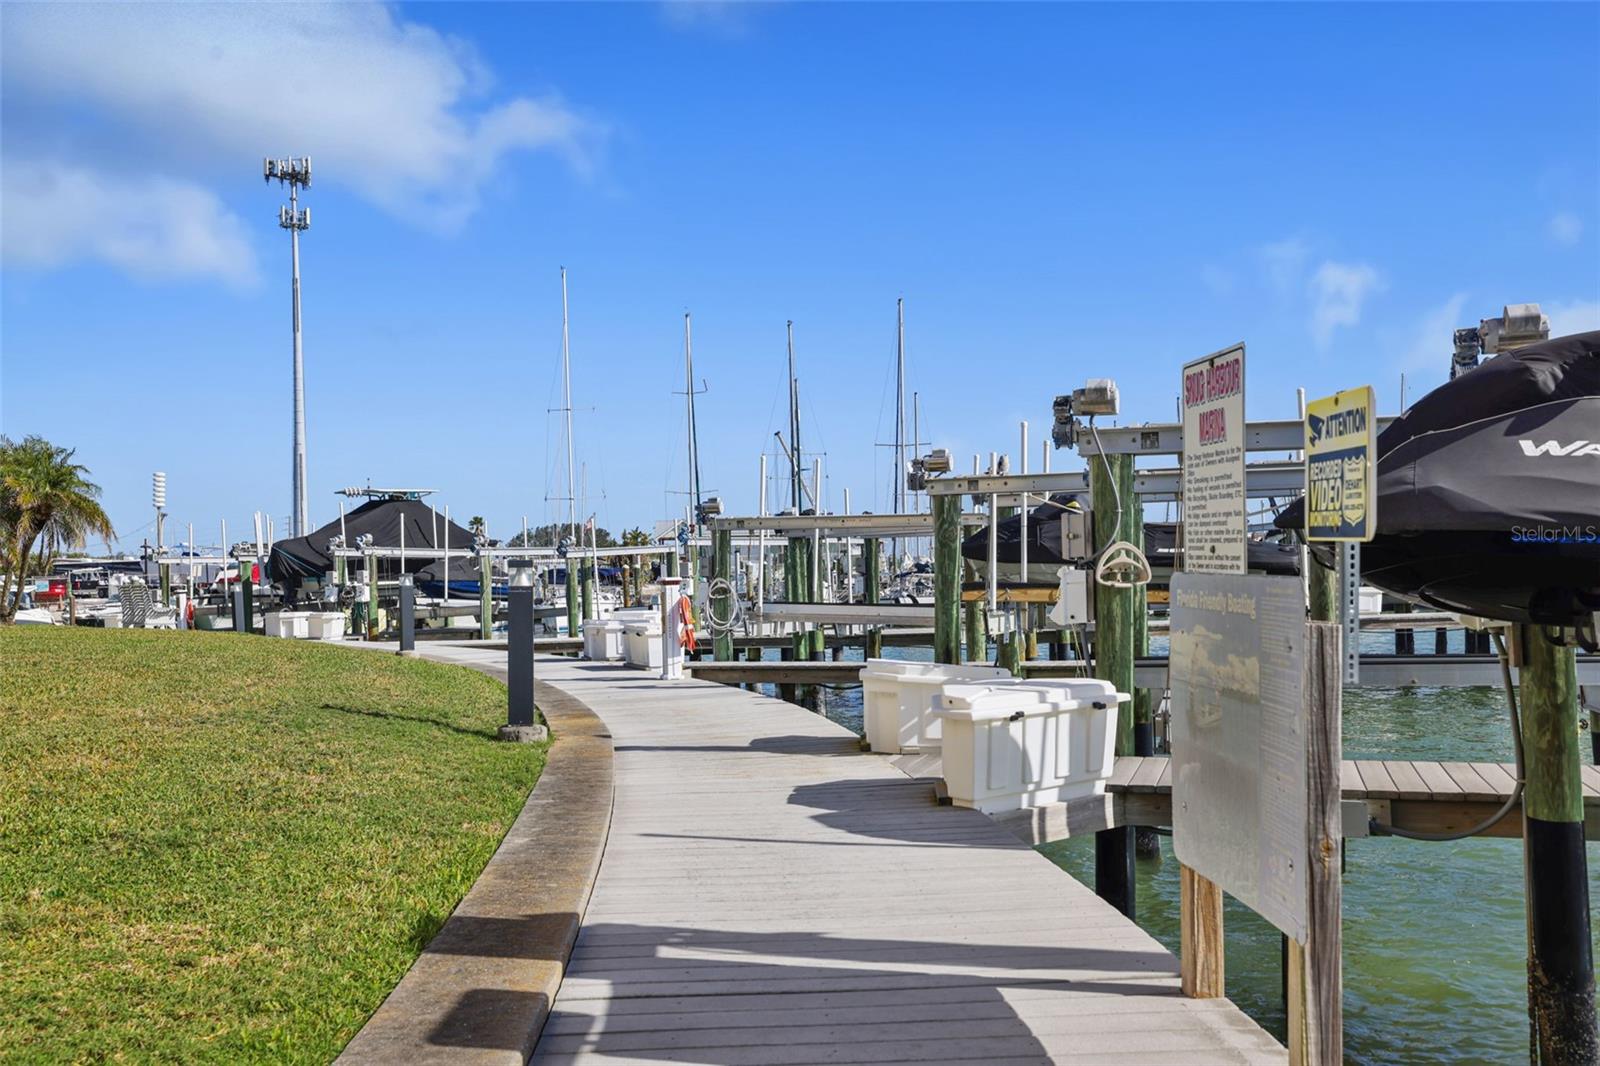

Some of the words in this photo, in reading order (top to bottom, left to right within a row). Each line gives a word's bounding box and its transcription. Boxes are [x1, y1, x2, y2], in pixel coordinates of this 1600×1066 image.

[1185, 369, 1206, 409] SNUG
[1206, 358, 1241, 403] HARBOUR
[1199, 407, 1227, 446] MARINA
[1325, 406, 1367, 440] ATTENTION
[1310, 459, 1343, 481] RECORDED
[1310, 479, 1343, 511] VIDEO
[1199, 590, 1227, 616] Friendly
[1227, 592, 1257, 620] Boating
